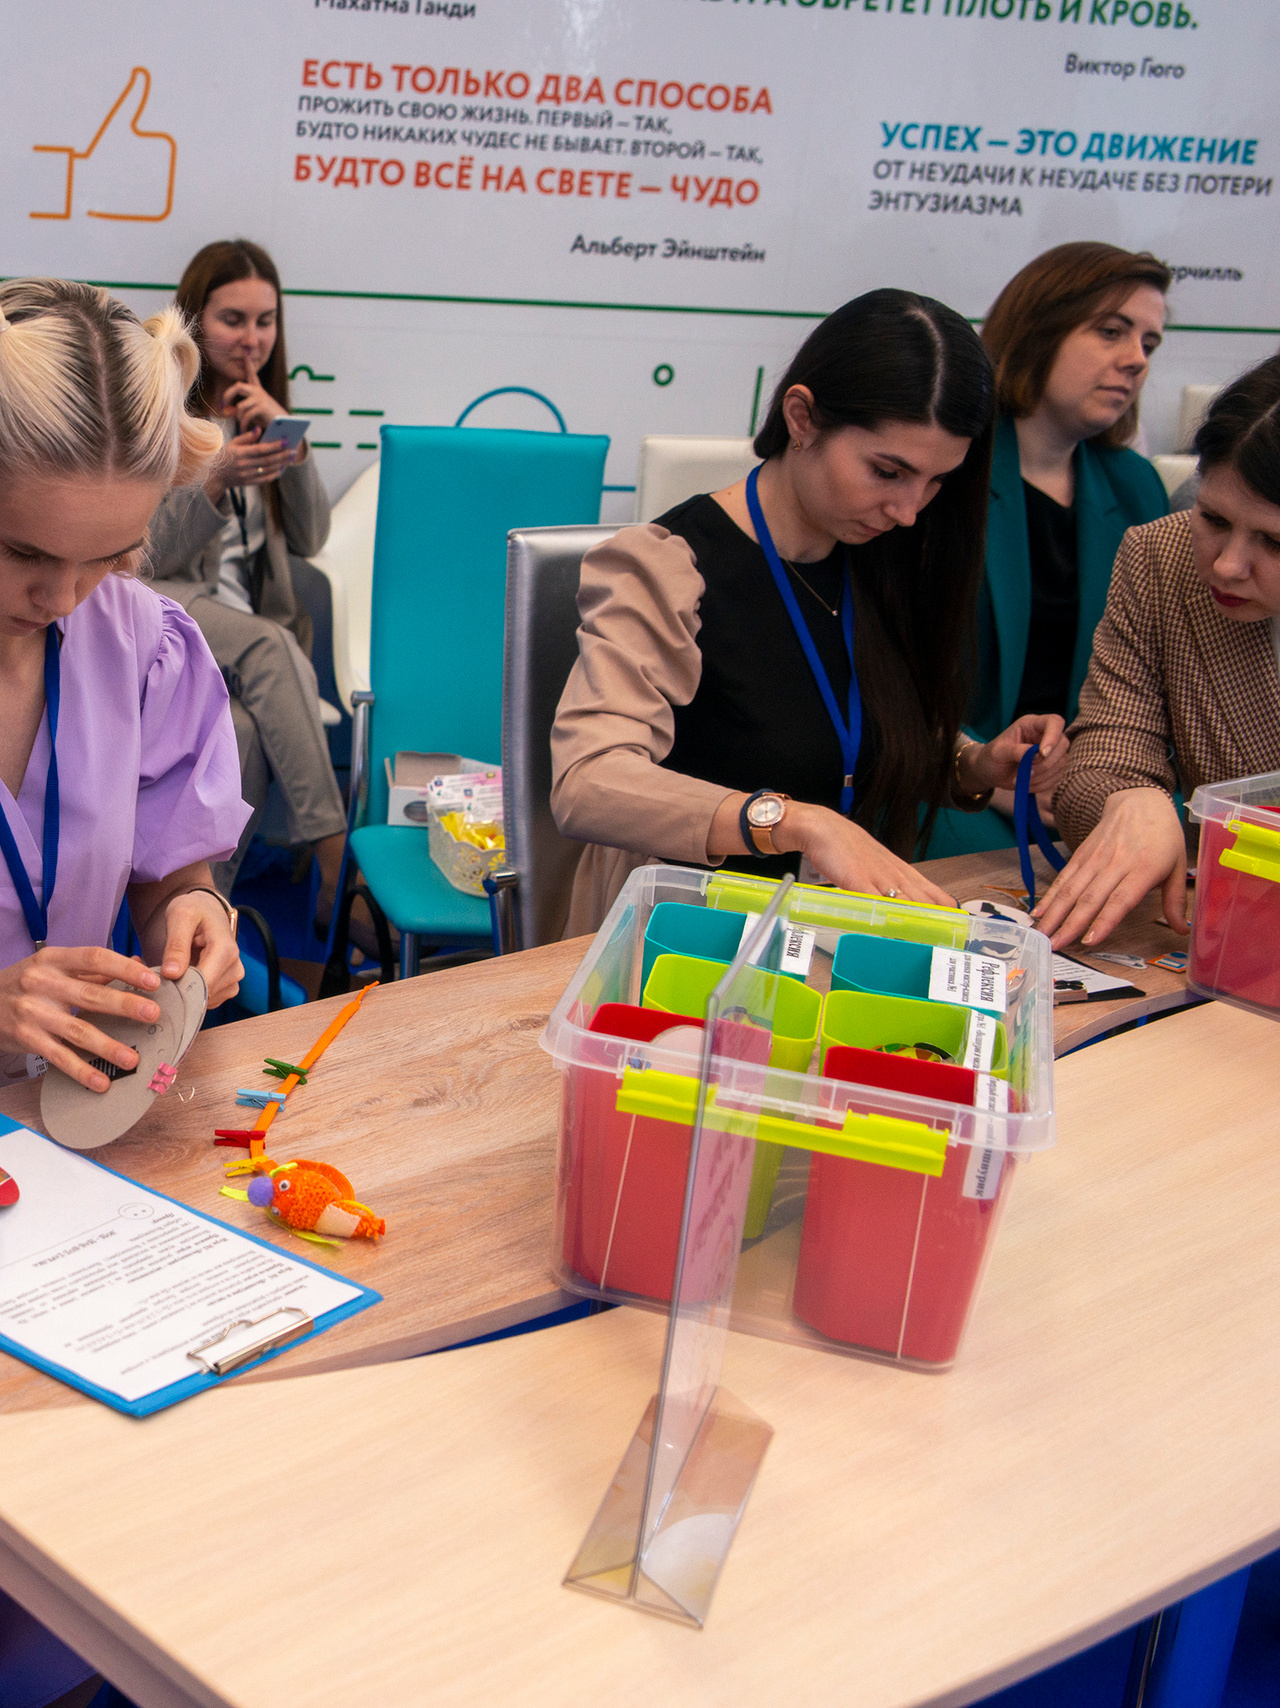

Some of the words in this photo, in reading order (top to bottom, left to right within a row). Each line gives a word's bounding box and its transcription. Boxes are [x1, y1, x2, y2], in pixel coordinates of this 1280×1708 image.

[1059, 0, 1081, 24] И
[1089, 0, 1199, 31] КРОВЬ.
[1065, 53, 1136, 81] Виктор
[1139, 56, 1187, 81] Гюго
[301, 59, 383, 92] ЕСТЬ
[391, 63, 531, 100] ТОЛЬКО
[535, 73, 607, 107] ДВА
[613, 79, 774, 116] СПОСОБА
[298, 95, 394, 119] ПРОЖИТЬ
[398, 101, 458, 122] СВОЮ
[461, 104, 532, 126] ЖИЗНЬ.
[537, 108, 613, 131] ПЕРВЫЙ
[634, 115, 673, 137] ТАК,
[296, 120, 359, 142] БУДТО
[362, 124, 457, 147] НИКАКИХ
[461, 130, 521, 152] ЧУДЕС
[524, 134, 549, 152] НЕ
[553, 135, 627, 156] БЫВАЕТ.
[630, 136, 707, 160] ВТОРОЙ
[727, 145, 764, 166] ТАК,
[880, 121, 982, 154] УСПЕХ
[1014, 129, 1079, 158] ЭТО
[1081, 132, 1259, 167] ДВИЖЕНИЕ
[294, 154, 408, 191] БУДТО
[414, 156, 475, 192] ВСЁ
[481, 165, 529, 195] НА
[535, 167, 633, 199] СВЕТЕ
[670, 174, 762, 211] ЧУДО
[873, 159, 907, 181] ОТ
[909, 161, 1017, 187] НЕУДАЧИ
[1020, 167, 1035, 187] К
[1039, 168, 1138, 193] НЕУДАЧЕ
[1142, 173, 1182, 194] БЕЗ
[1185, 175, 1274, 198] ПОТЕРИ
[868, 190, 1024, 217] ЭНТУЗИАЗМА
[570, 234, 658, 261] Альберт
[661, 238, 767, 264] Эйнштейн
[1167, 264, 1243, 284] ерчилль
[976, 960, 1000, 1003] Рефлексия
